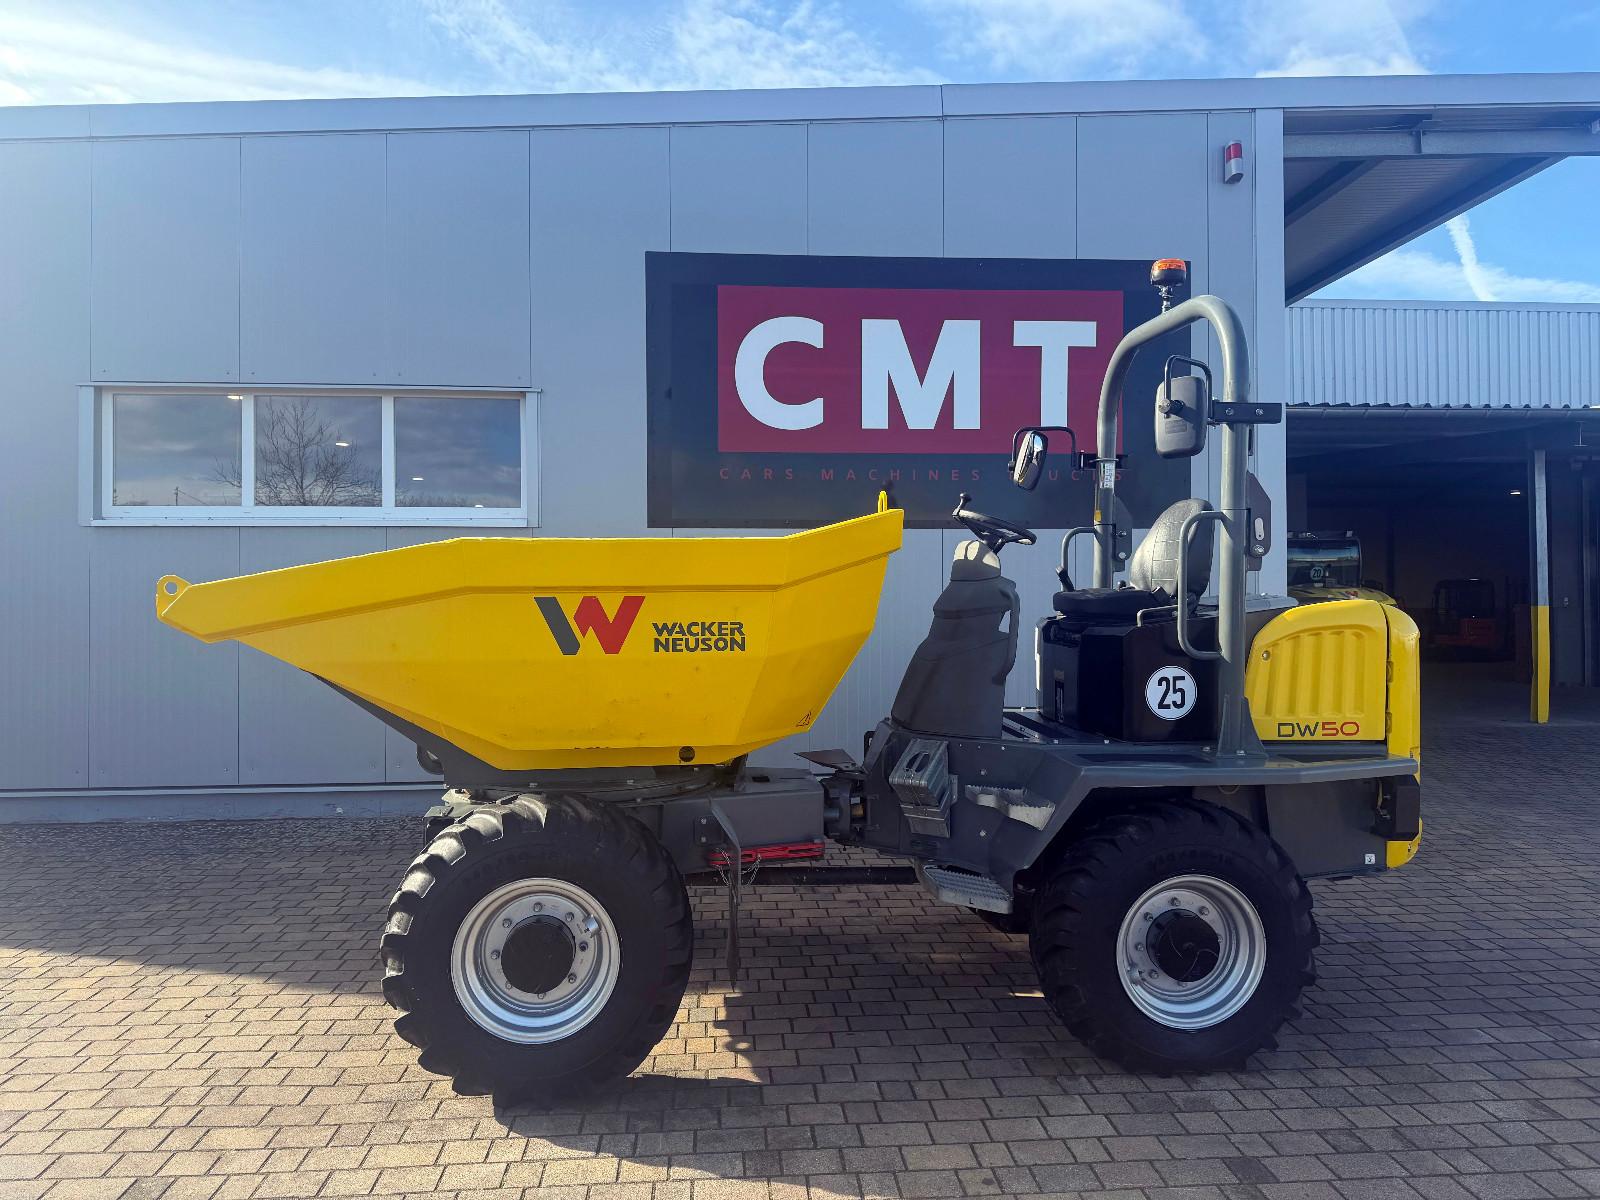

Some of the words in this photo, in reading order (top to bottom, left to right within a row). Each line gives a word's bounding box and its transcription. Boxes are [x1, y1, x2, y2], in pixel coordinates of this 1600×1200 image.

[734, 315, 1098, 431] CMT
[719, 467, 793, 481] CARS
[820, 468, 980, 482] MACHINES
[651, 621, 745, 637] WACKER
[653, 636, 746, 653] NEUSON
[1157, 675, 1186, 710] 25
[1277, 721, 1360, 738] DW50
